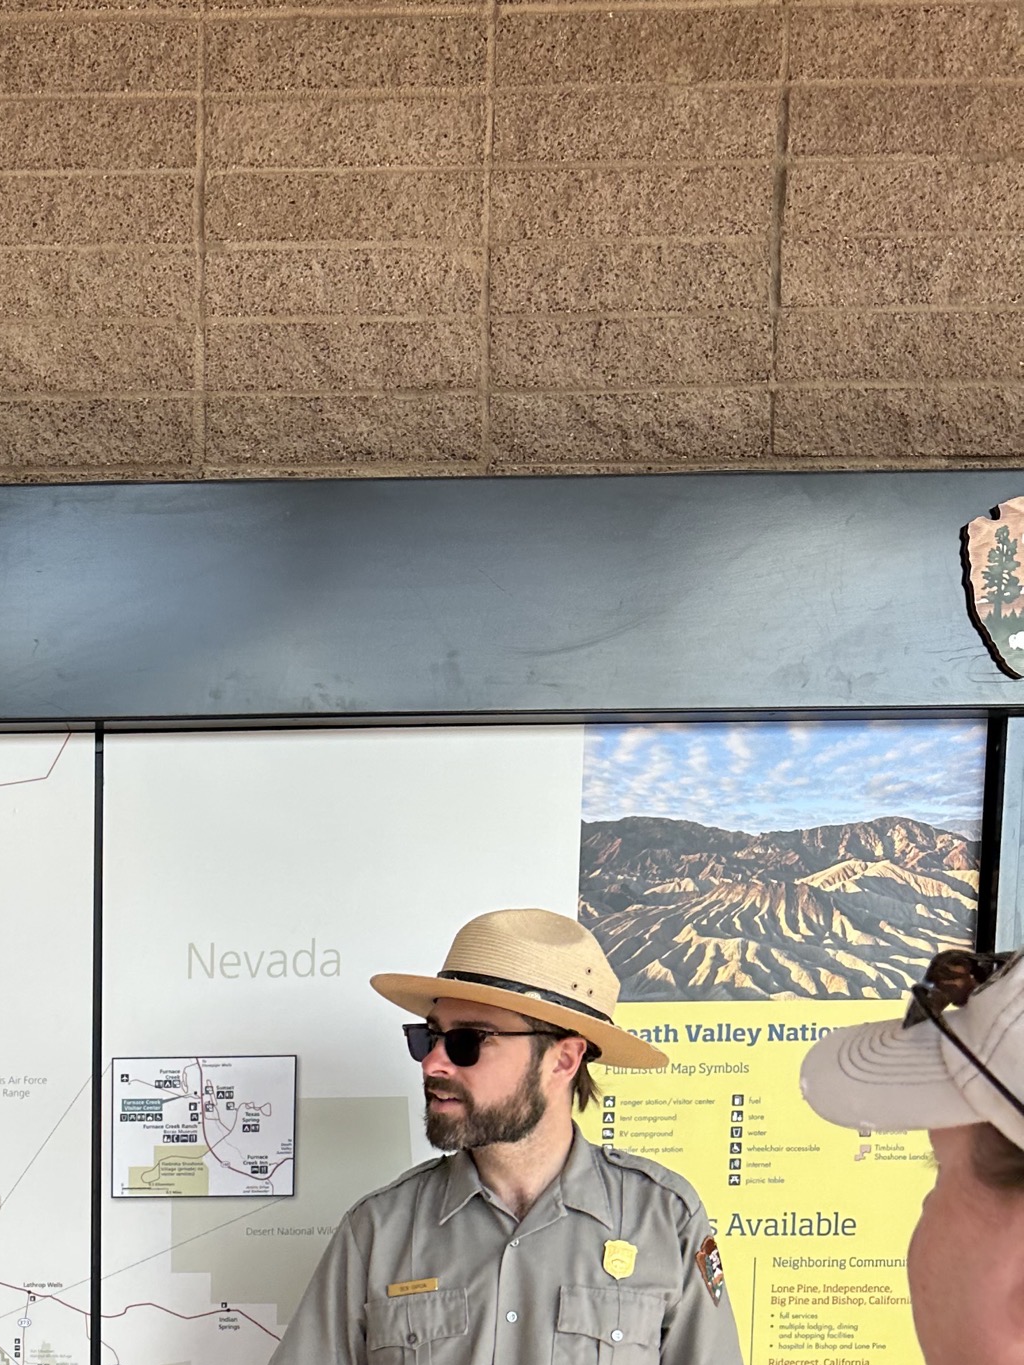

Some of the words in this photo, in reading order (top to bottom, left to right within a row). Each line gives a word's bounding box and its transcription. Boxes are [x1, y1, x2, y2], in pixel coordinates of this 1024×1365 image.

[186, 937, 342, 980] Nevada
[621, 1024, 678, 1043] eath
[685, 1024, 765, 1046] Valley
[671, 1063, 696, 1076] Map
[699, 1062, 749, 1076] Symbols
[9, 1076, 21, 1084] Air
[24, 1076, 47, 1084] Force
[3, 1089, 30, 1099] Range
[630, 1130, 673, 1139] campground
[640, 1146, 660, 1155] dump
[786, 1144, 820, 1152] accessible
[725, 1211, 857, 1237] Available
[245, 1226, 274, 1236] Desert
[277, 1227, 314, 1235] National
[773, 1257, 846, 1270] Neighboring
[849, 1257, 908, 1267] Communi
[771, 1284, 795, 1293] Lone
[797, 1284, 820, 1293] Pine,
[823, 1284, 892, 1294] Independence,
[771, 1296, 786, 1306] Big
[788, 1296, 809, 1305] Pine
[812, 1296, 829, 1305] and
[832, 1296, 866, 1306] Bishop,
[794, 1332, 825, 1340] shopping
